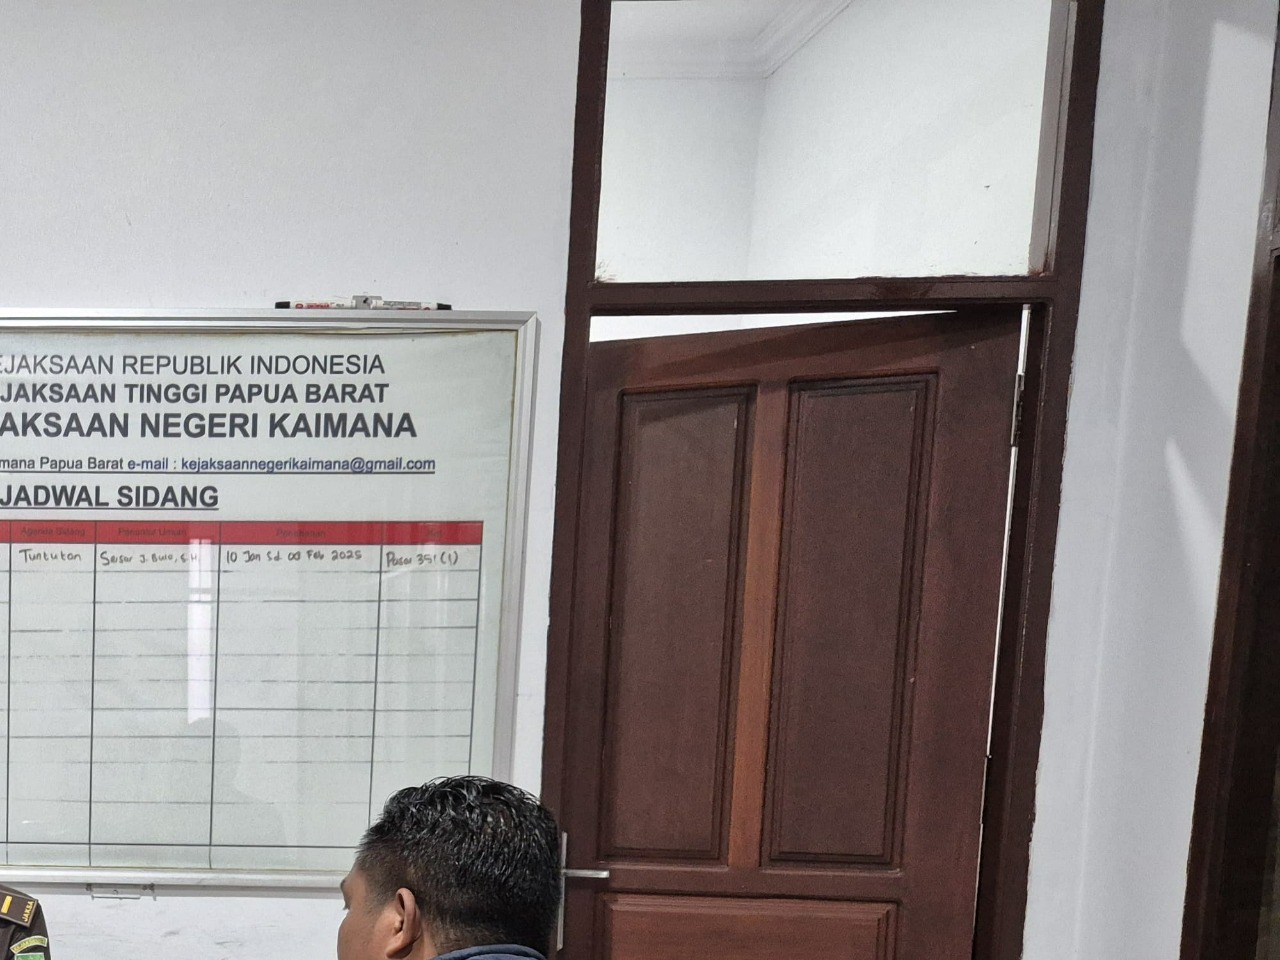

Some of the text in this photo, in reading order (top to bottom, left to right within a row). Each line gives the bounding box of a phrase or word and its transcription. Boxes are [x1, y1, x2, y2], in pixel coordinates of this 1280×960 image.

[121, 354, 242, 375] REPUBLIK
[249, 354, 385, 375] INDONESIA
[124, 383, 208, 404] TINGGI
[215, 383, 299, 404] PAPUA
[306, 383, 389, 404] BARAT
[139, 412, 259, 438] NEGERI
[268, 412, 417, 438] KAIMANA
[39, 456, 83, 472] Papua
[87, 457, 123, 470] Barat
[127, 456, 169, 470] e-mail
[181, 457, 436, 472] kejaksaannegerikaimana@gmail.com
[117, 485, 219, 508] SIDANG
[226, 550, 238, 564] 10
[243, 550, 261, 563] Jan
[331, 550, 363, 562] 2025
[22, 900, 35, 923] JAKSA
